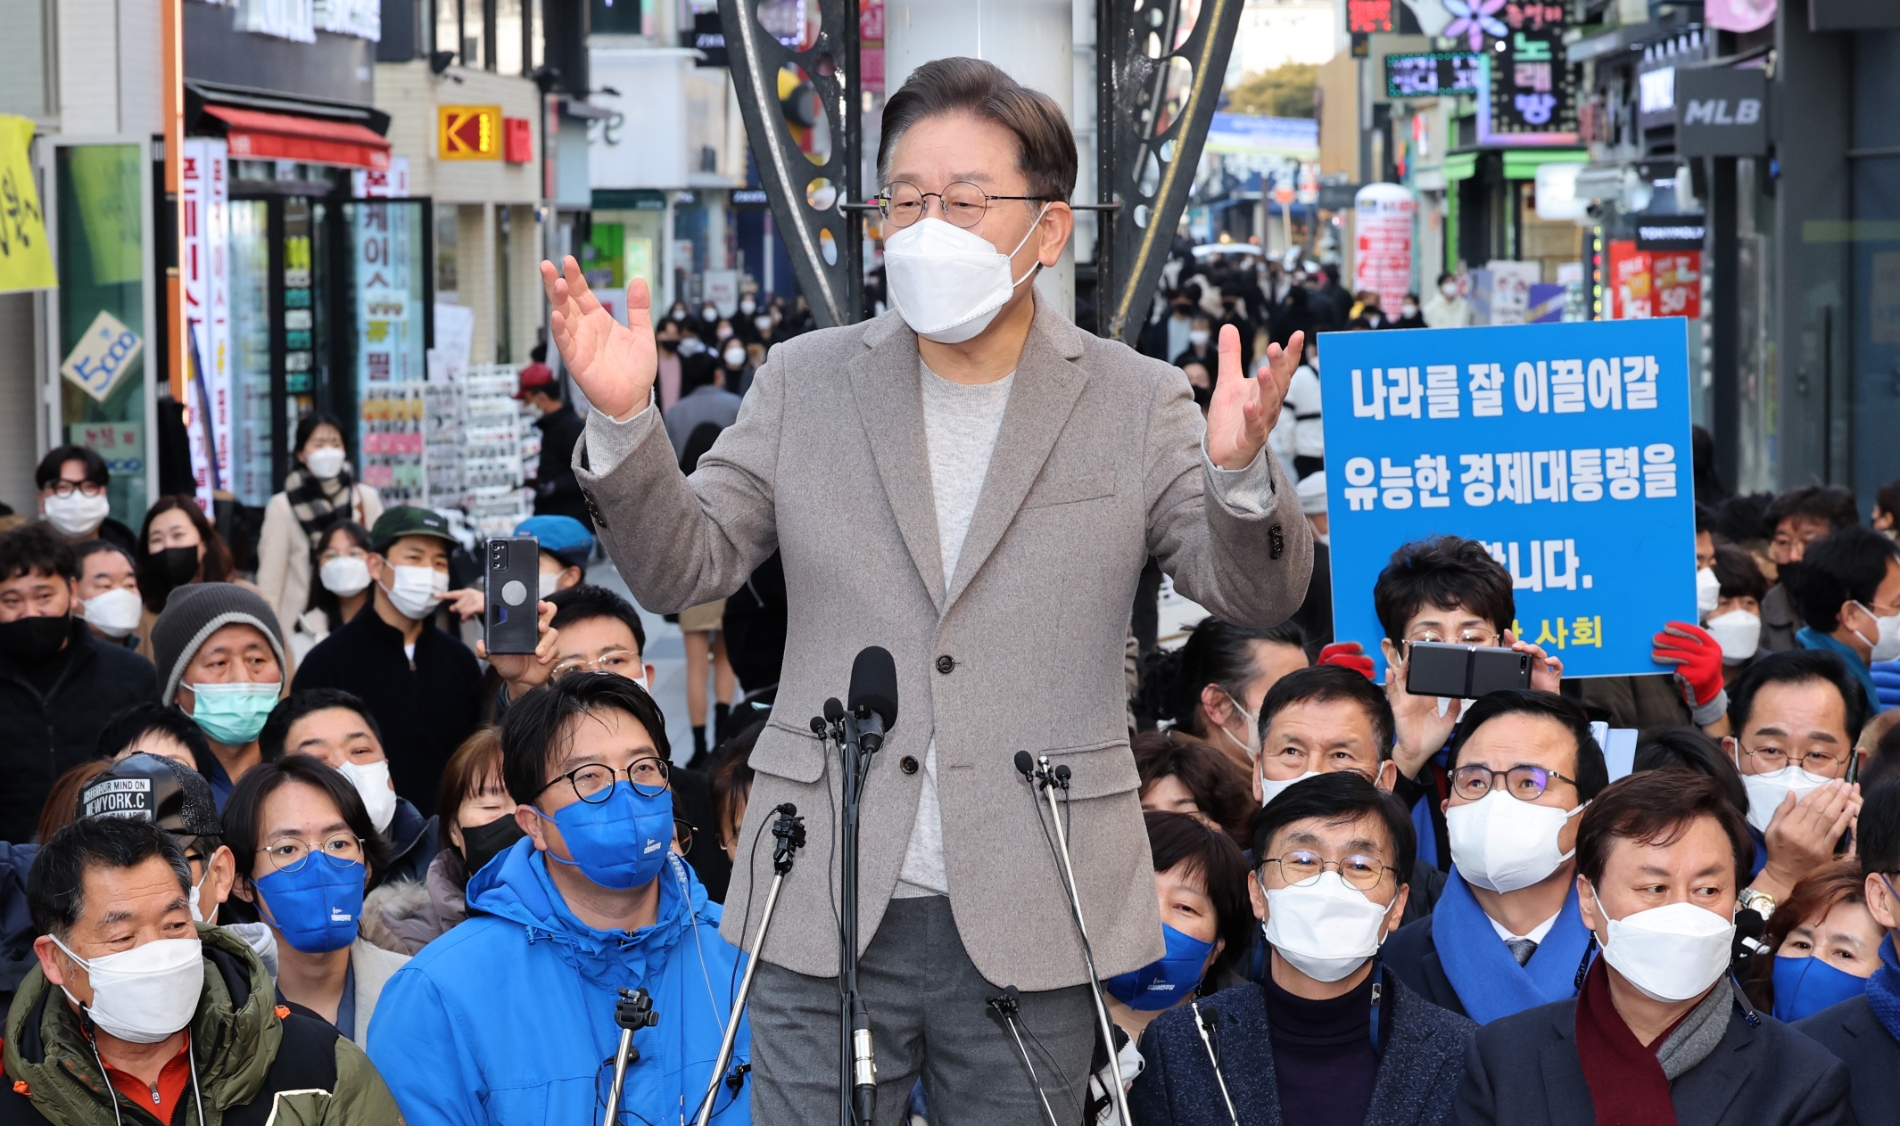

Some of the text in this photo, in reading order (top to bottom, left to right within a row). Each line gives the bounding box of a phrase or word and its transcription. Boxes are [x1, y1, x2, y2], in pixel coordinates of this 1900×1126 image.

[1684, 98, 1761, 125] MLB
[73, 331, 136, 392] 5000
[1351, 356, 1659, 420] 나라를 잘 이끌어갈
[1343, 443, 1677, 511] 유능한 경제대통령을
[1535, 615, 1603, 650] 사회
[114, 780, 132, 791] MIND
[135, 780, 145, 790] ON
